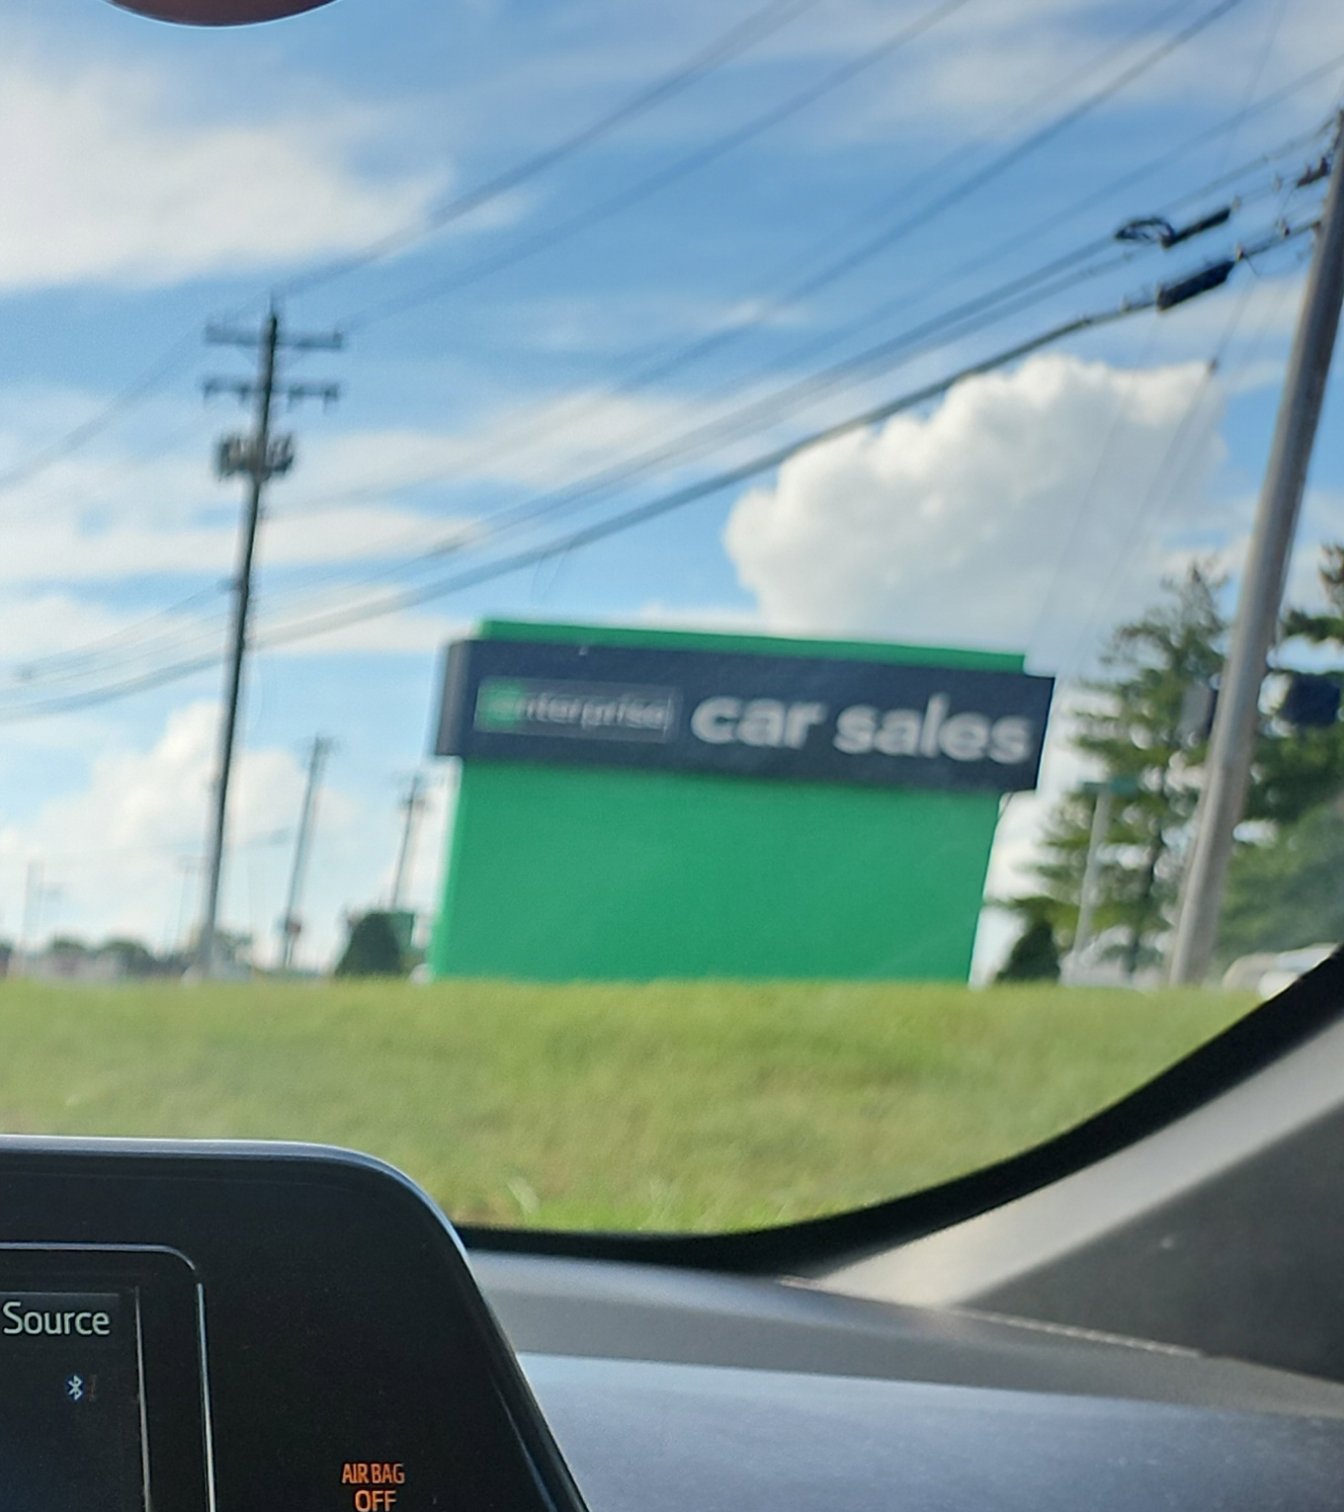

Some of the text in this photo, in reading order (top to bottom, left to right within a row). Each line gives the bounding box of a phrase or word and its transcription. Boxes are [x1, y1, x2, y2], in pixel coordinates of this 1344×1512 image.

[690, 695, 827, 750] car
[833, 692, 1034, 766] sales
[2, 1301, 112, 1336] Source
[341, 1463, 405, 1486] AIR BAG
[354, 1489, 397, 1512] OFF
